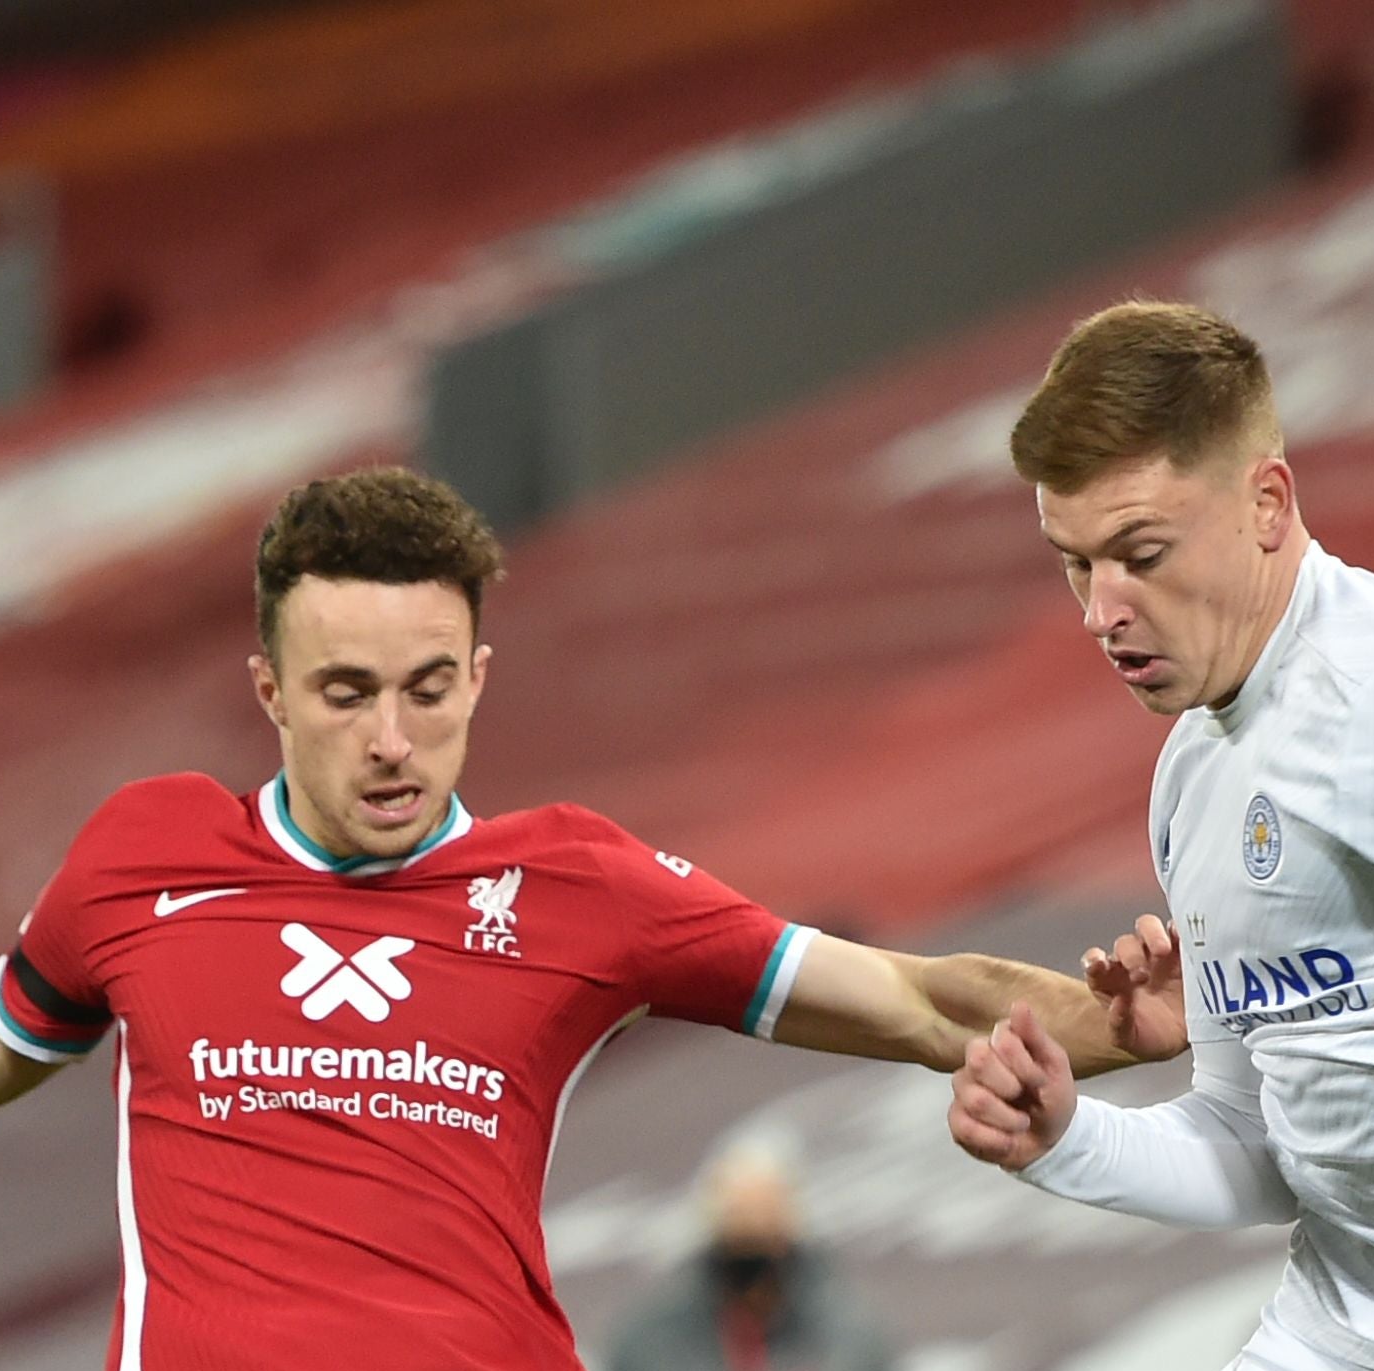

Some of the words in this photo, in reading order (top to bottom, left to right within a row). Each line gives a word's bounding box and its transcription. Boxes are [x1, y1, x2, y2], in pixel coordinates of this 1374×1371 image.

[189, 1038, 505, 1101] futuremakers
[199, 1092, 233, 1121] by
[238, 1086, 362, 1117] Standard
[368, 1092, 498, 1140] Chartered
